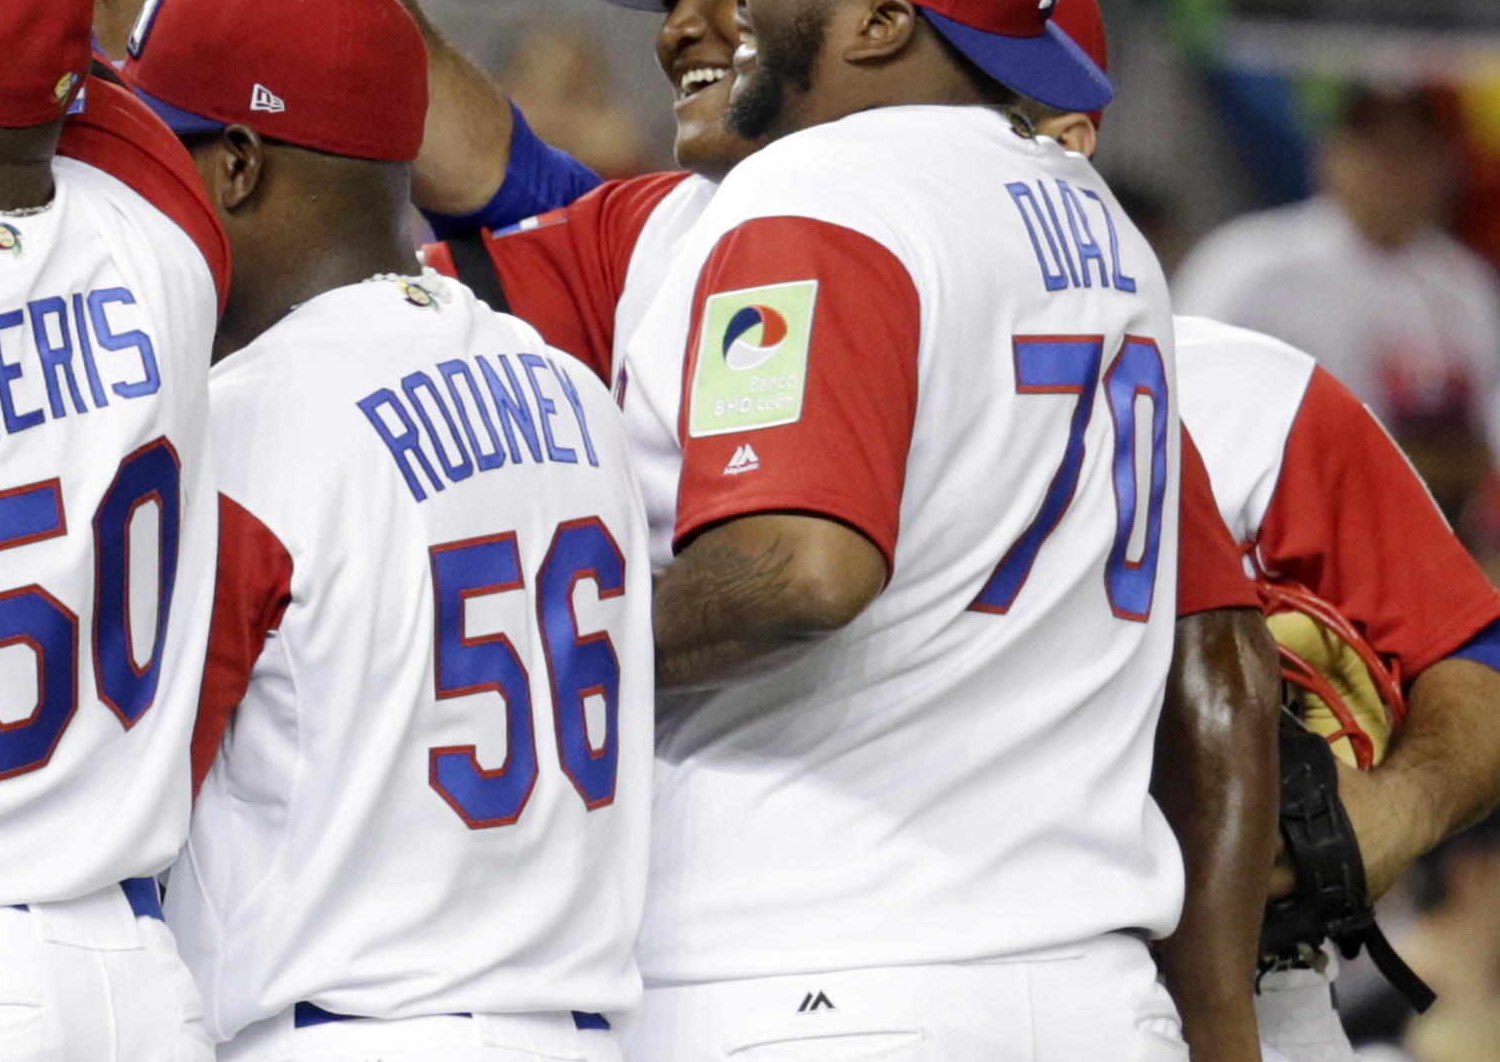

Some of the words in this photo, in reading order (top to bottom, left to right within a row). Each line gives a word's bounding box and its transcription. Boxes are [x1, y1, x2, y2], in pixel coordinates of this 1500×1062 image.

[1003, 178, 1137, 293] DIAZ
[355, 353, 600, 504] RODNEY
[714, 396, 751, 416] BHD
[749, 374, 797, 392] Banco
[966, 334, 1169, 624] 70
[428, 515, 626, 830] 56
